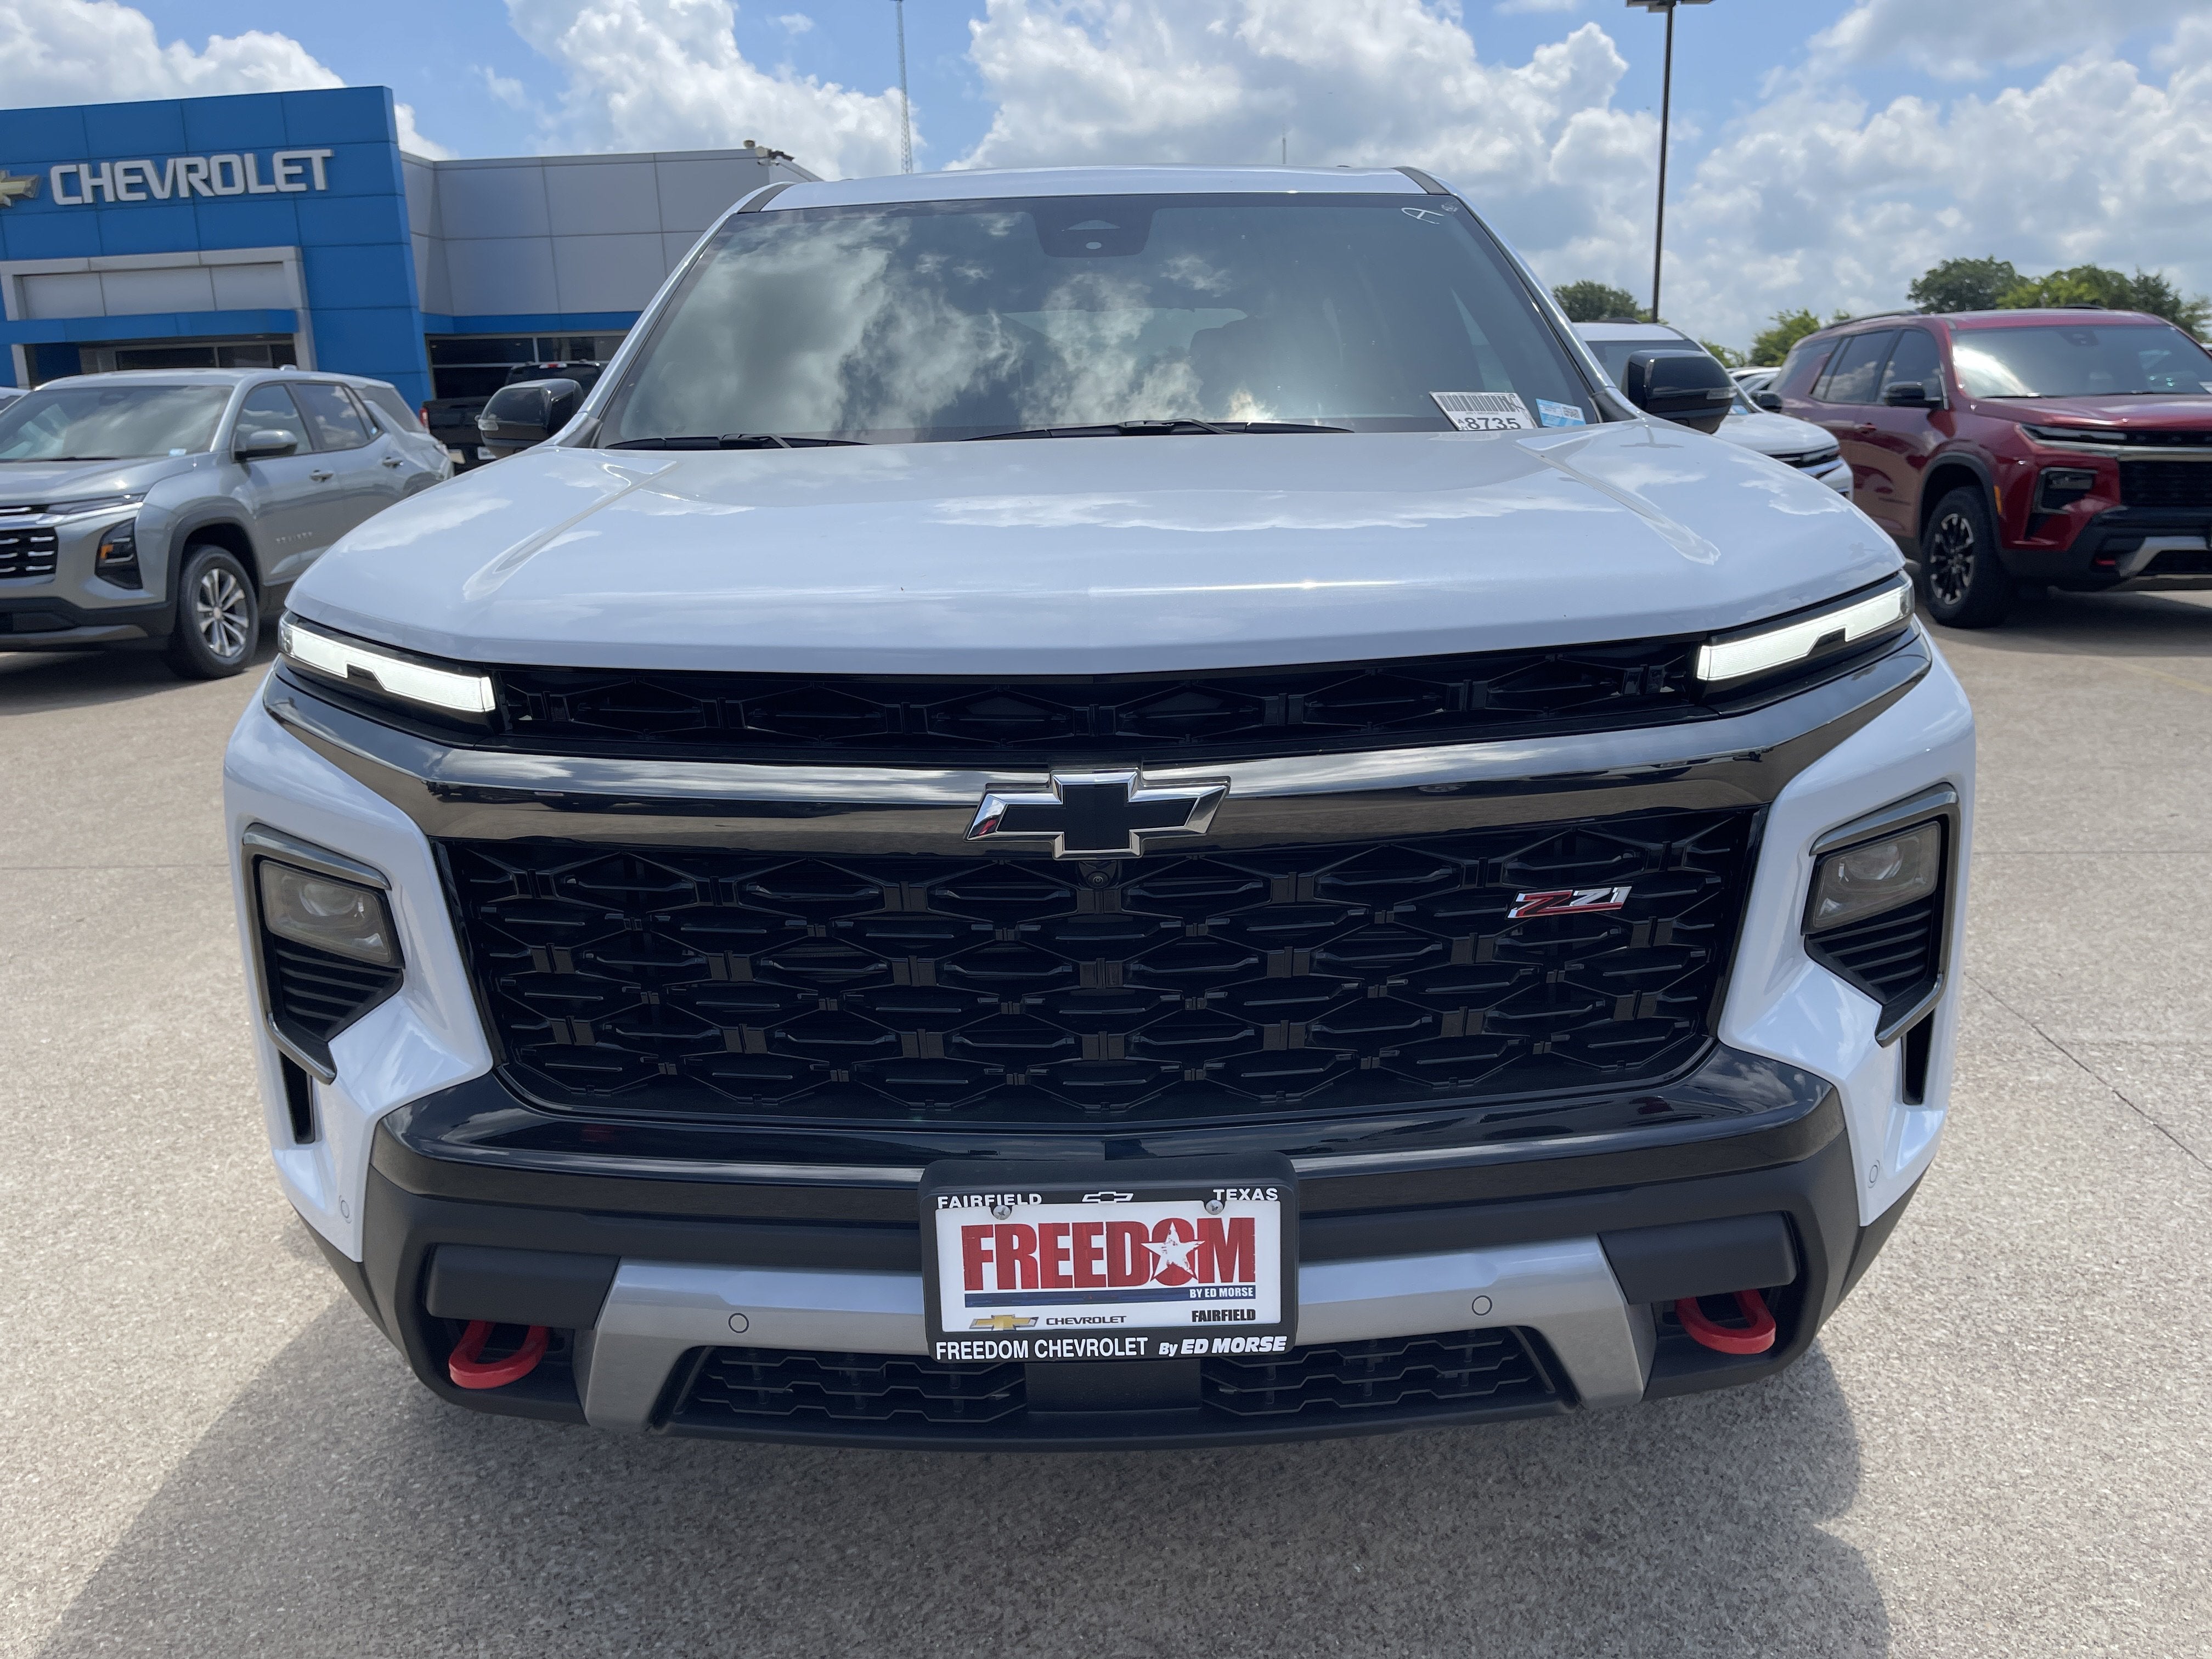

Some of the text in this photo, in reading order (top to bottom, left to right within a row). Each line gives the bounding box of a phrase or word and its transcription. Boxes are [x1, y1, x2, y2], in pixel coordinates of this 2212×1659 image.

[50, 149, 333, 205] CHEVROLET
[1464, 417, 1521, 430] 8735
[1508, 886, 1632, 918] Z71
[937, 1193, 1042, 1209] FAIRFIELD
[1213, 1188, 1278, 1201] TEXAS
[961, 1217, 1256, 1291] FREEDOM
[1189, 1287, 1254, 1298] BY ED MORSE
[1046, 1316, 1127, 1325] CHEVROLET
[1192, 1309, 1256, 1322] FAIRFIELD
[936, 1336, 1288, 1360] FREEDOM CHEVROLET By ED MORSE
